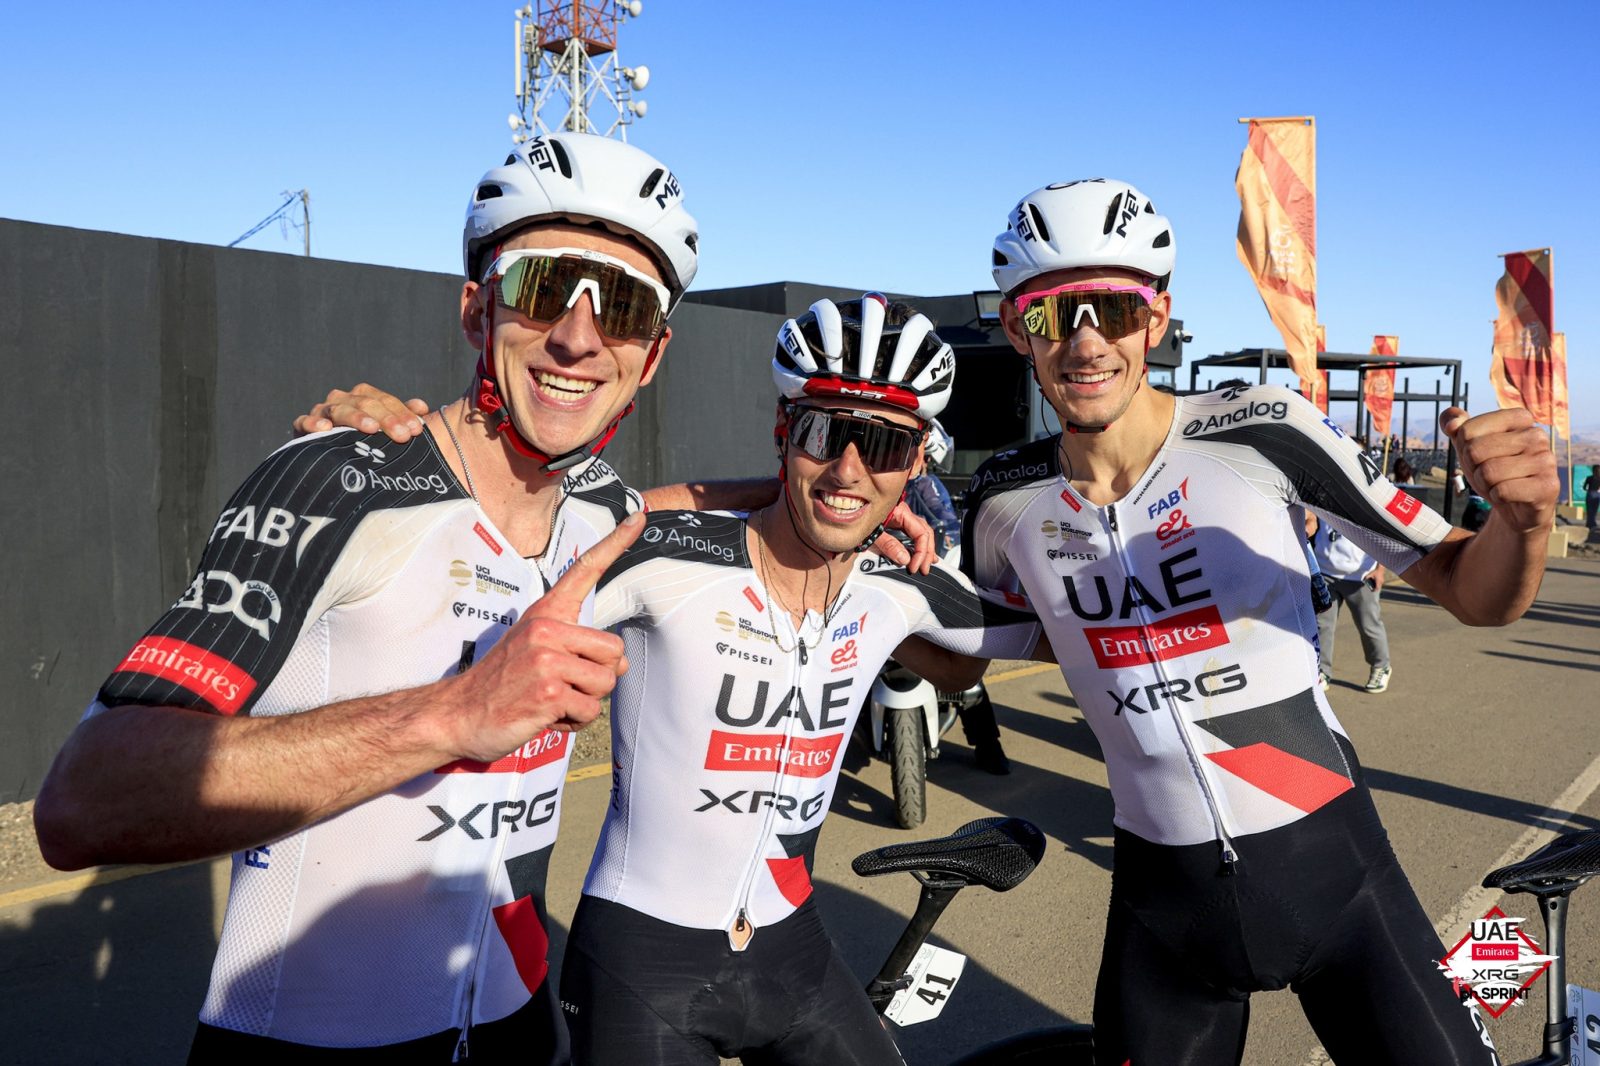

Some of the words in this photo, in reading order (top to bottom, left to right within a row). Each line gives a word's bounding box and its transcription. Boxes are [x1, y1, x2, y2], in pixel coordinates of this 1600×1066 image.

[528, 136, 556, 173] MET
[1014, 202, 1038, 243] MET
[1116, 189, 1140, 239] MET
[783, 323, 805, 358] MET
[840, 387, 887, 400] MET
[1203, 400, 1288, 432] Analog
[369, 469, 449, 495] Analog
[980, 461, 1048, 486] Analog
[665, 528, 735, 562] Analog
[1059, 552, 1098, 561] PISSEI
[475, 564, 491, 576] UCI
[475, 572, 520, 593] WORLDTOUR
[1062, 547, 1212, 622] UAE
[468, 607, 514, 627] PISSEI
[1098, 621, 1213, 658] Emirates
[127, 643, 240, 702] Emirates
[729, 648, 773, 666] PISSEI
[715, 673, 854, 732] UAE
[1106, 663, 1248, 717] XRG
[723, 743, 832, 767] Emirates
[415, 788, 559, 842] XRG
[693, 788, 826, 823] XRG
[916, 973, 957, 1006] 41
